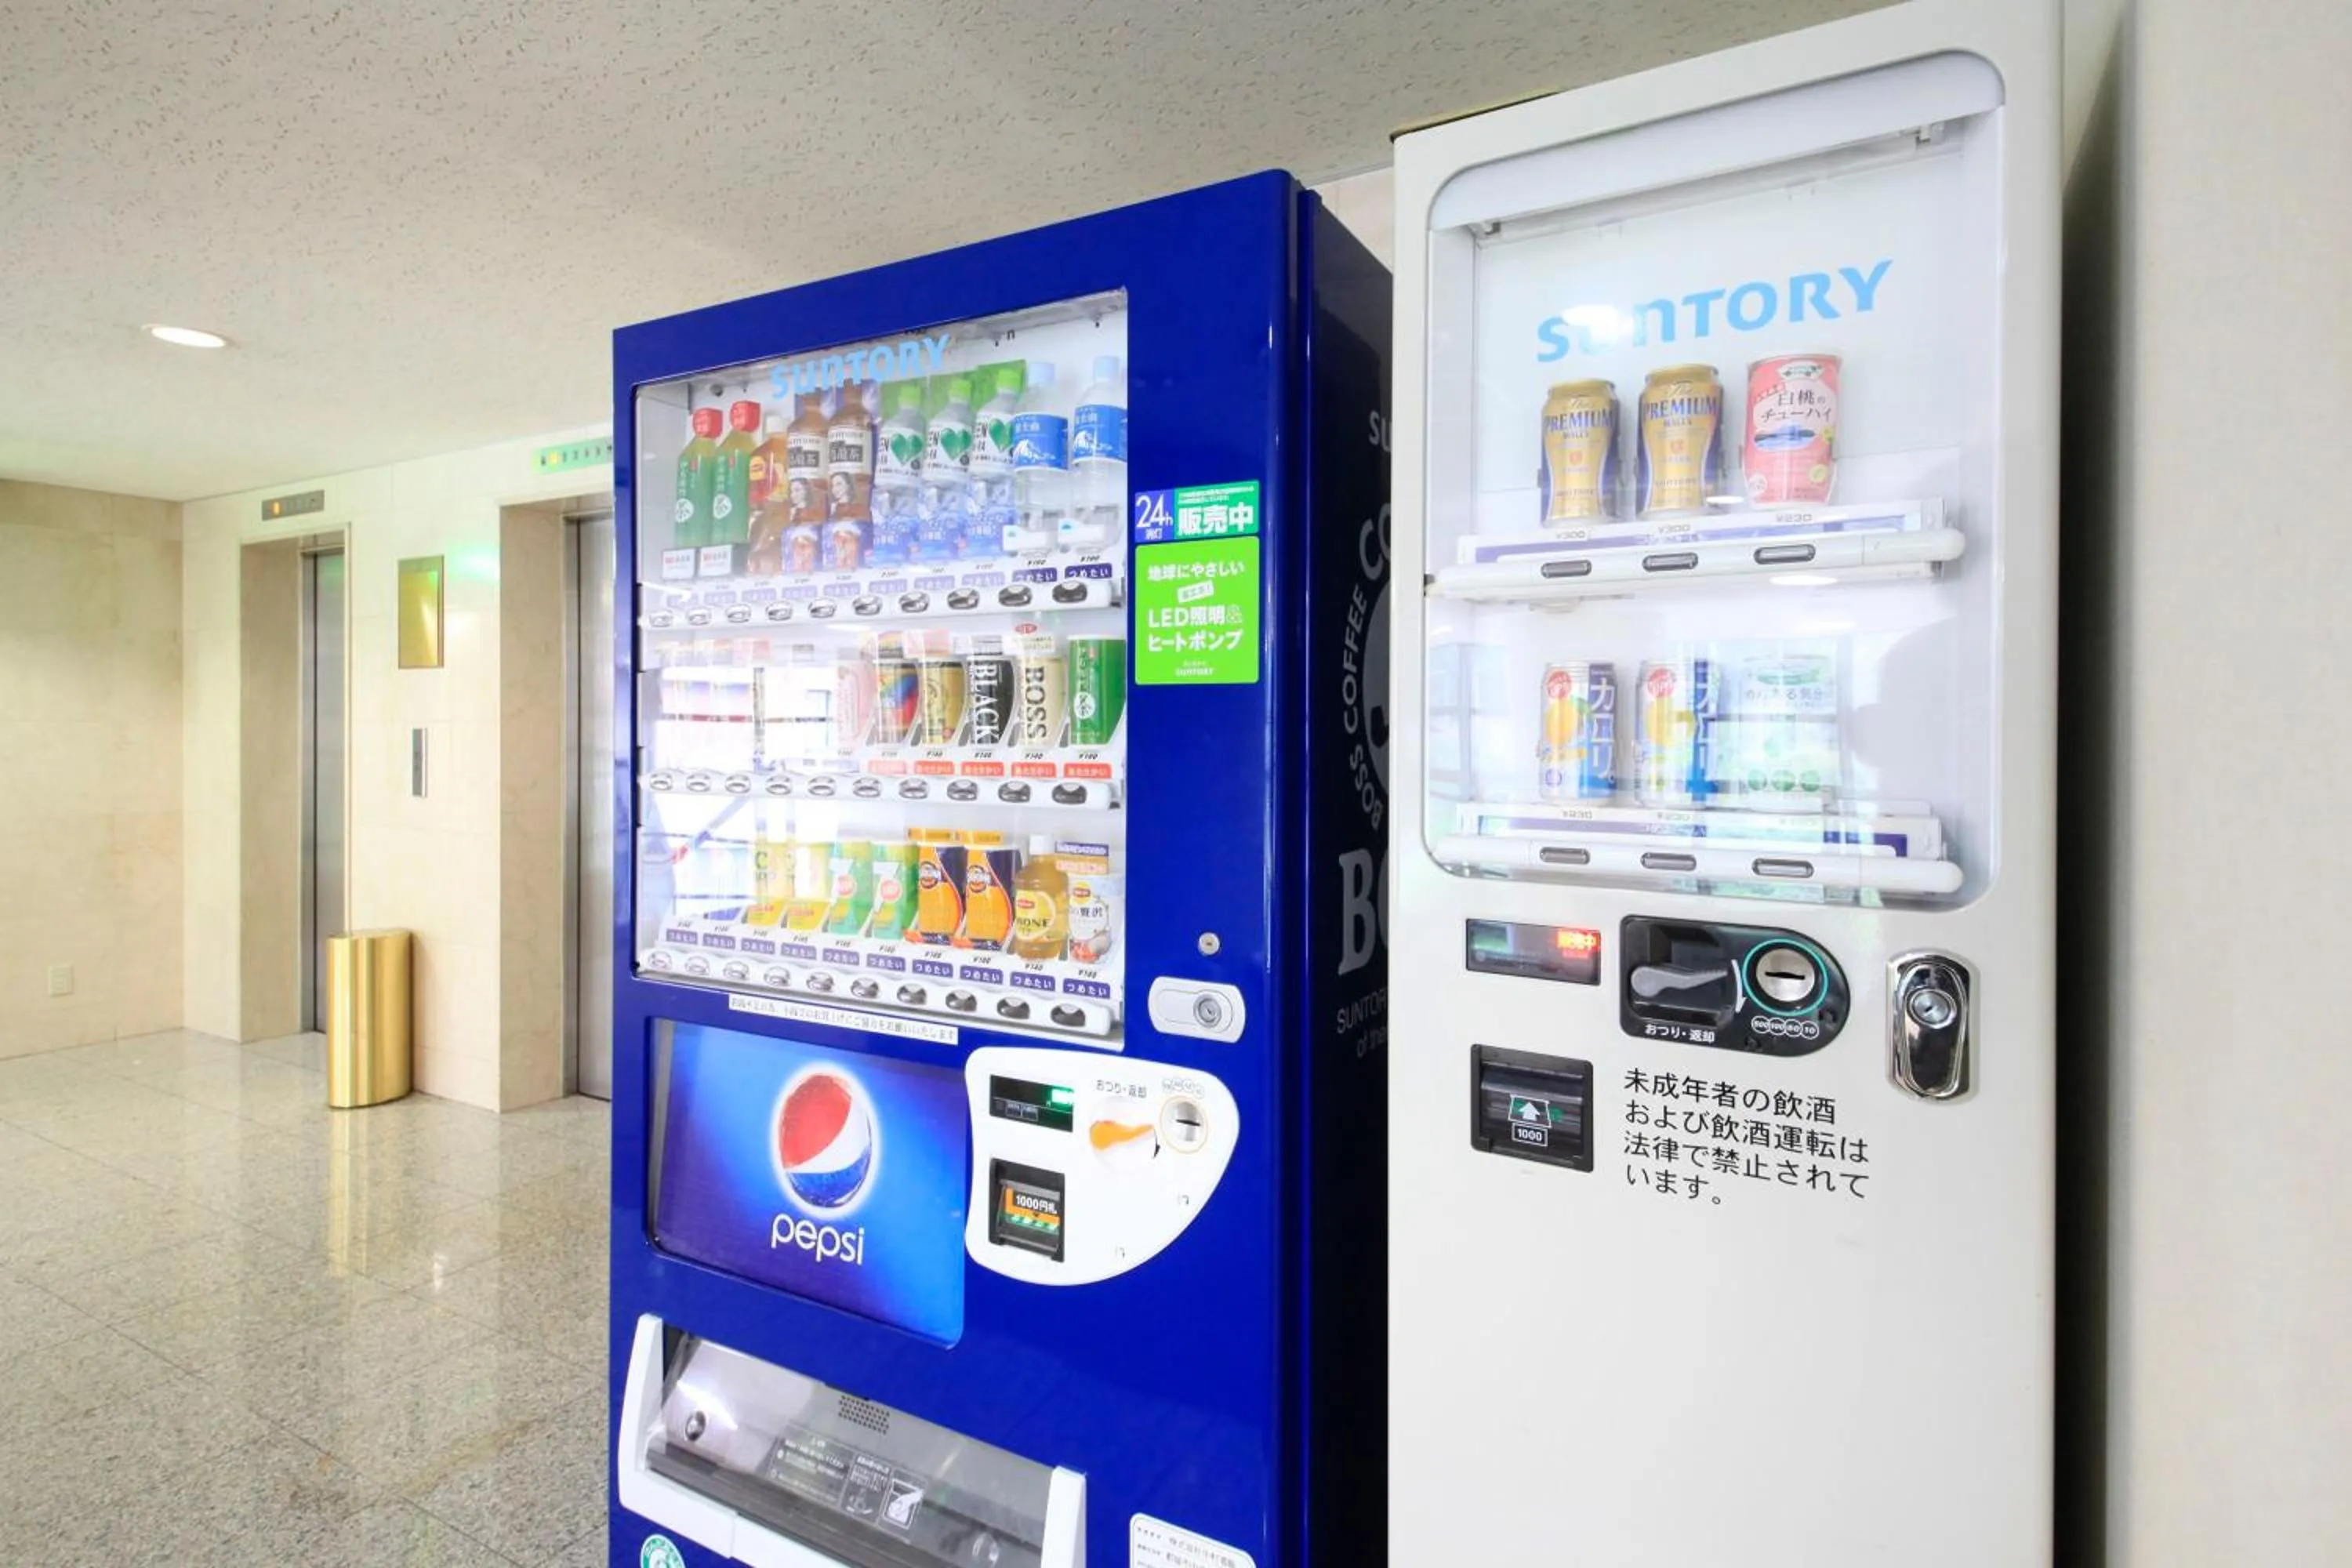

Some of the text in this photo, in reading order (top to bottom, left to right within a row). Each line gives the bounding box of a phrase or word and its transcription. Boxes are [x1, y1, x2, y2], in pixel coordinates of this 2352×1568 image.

[770, 333, 951, 401] SUNTORY
[1646, 396, 1719, 420] PREMIUM
[1777, 389, 1827, 407] 白桃の
[1544, 407, 1615, 433] PREMIUM
[1761, 408, 1832, 424] チューハイ
[1136, 493, 1174, 528] 24h
[1178, 501, 1254, 536] 販売中
[1148, 561, 1244, 581] 地球にやさしい
[1148, 630, 1243, 652] ヒートポンプ
[1342, 585, 1367, 735] COFFEE
[975, 663, 1000, 743] BLACK
[1025, 666, 1047, 739] BOSS
[915, 964, 950, 975] つめたい
[964, 970, 1000, 982] つめたい
[1014, 976, 1051, 989] つめたい
[1067, 983, 1107, 996] つめたい
[1645, 1024, 1715, 1044] おつり・返却
[1624, 1067, 1836, 1125] 未成年者の飲酒
[1517, 1128, 1542, 1142] 1000
[1624, 1099, 1869, 1163] および飲酒運転は
[1624, 1130, 1870, 1199] 法律で禁止されて
[1627, 1164, 1722, 1205] います。
[771, 1213, 865, 1265] pepsi
